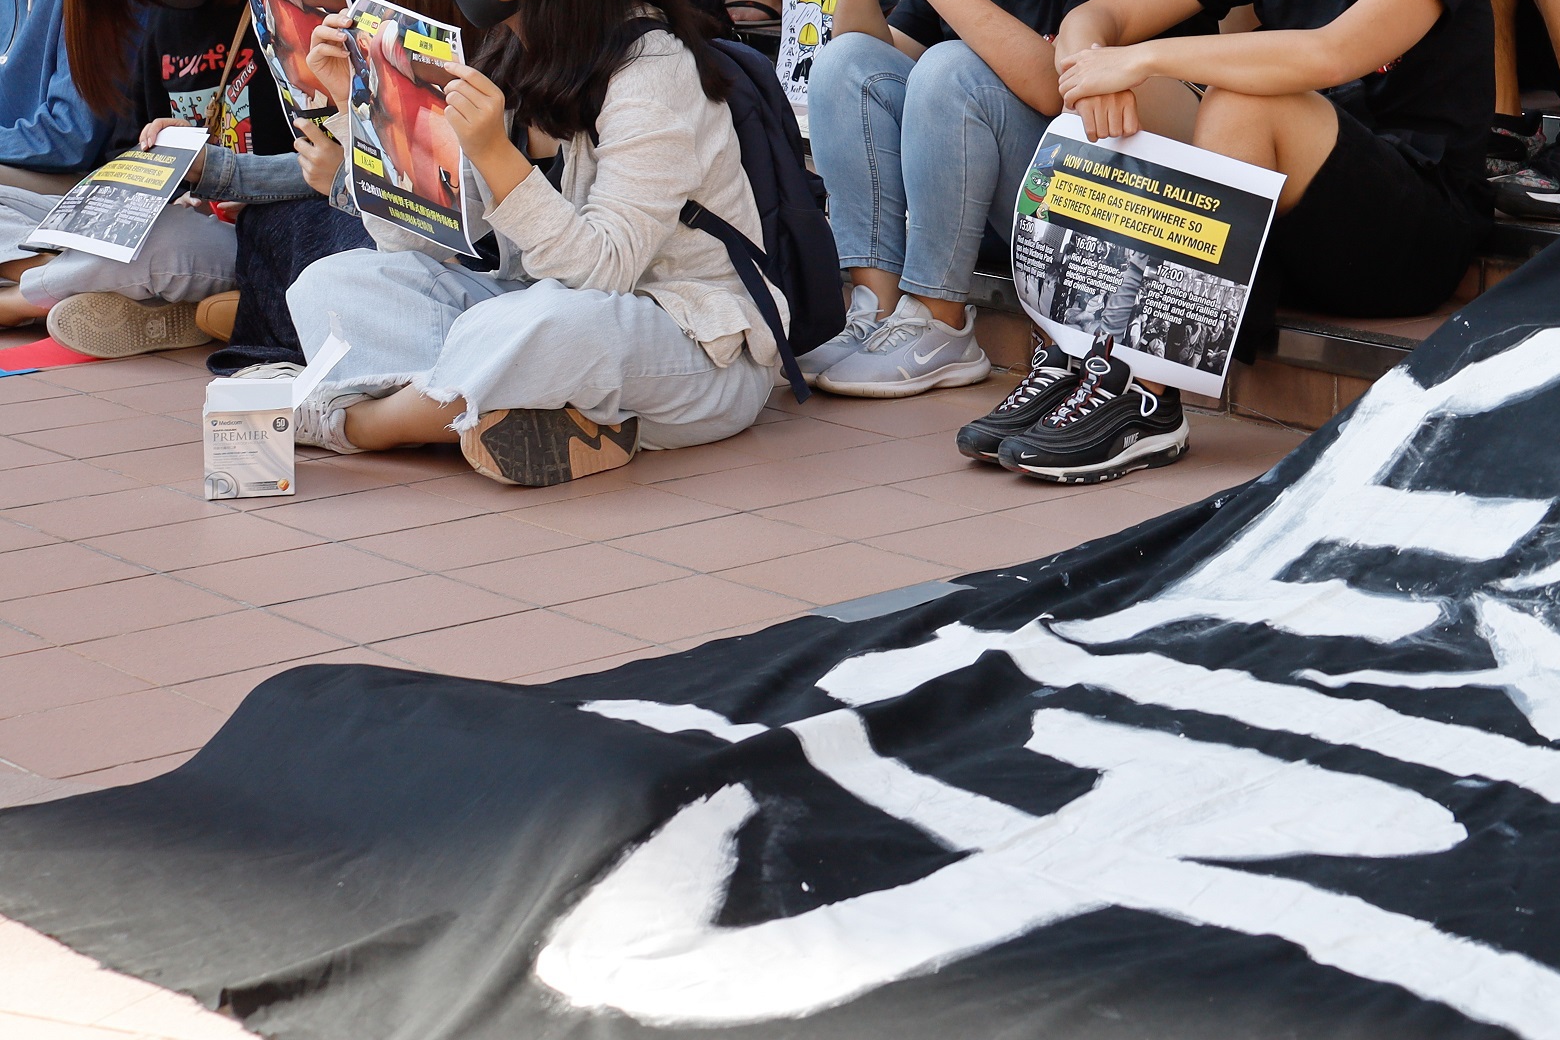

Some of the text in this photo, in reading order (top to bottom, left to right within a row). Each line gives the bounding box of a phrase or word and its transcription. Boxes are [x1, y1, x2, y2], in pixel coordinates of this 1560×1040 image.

[361, 155, 375, 169] 18:45
[1063, 154, 1221, 212] HOW TO BAN PEACEFUL RALLIES?
[1055, 178, 1202, 234] LET'S FIRE TEAR GAS EVERYWHERE SO
[1020, 219, 1034, 233] 15:00
[1050, 193, 1217, 256] THE STREETS AREN'T PEACEFUL ANYMORE
[1076, 237, 1096, 252] 16:00
[1071, 252, 1081, 262] Riot
[1081, 257, 1098, 268] police
[1066, 270, 1117, 293] election candidates
[1087, 268, 1098, 276] and
[1098, 272, 1123, 285] arrested
[1156, 264, 1184, 282] 17:00
[1063, 279, 1096, 295] and civilians
[1151, 280, 1216, 308] Riot police banned
[1145, 299, 1218, 327] central and detained
[1148, 289, 1227, 321] pre-approved rallies in
[1142, 307, 1183, 326] 50 civilians
[276, 419, 285, 427] 50
[213, 431, 269, 442] PREMIER
[1123, 432, 1140, 449] NIKE
